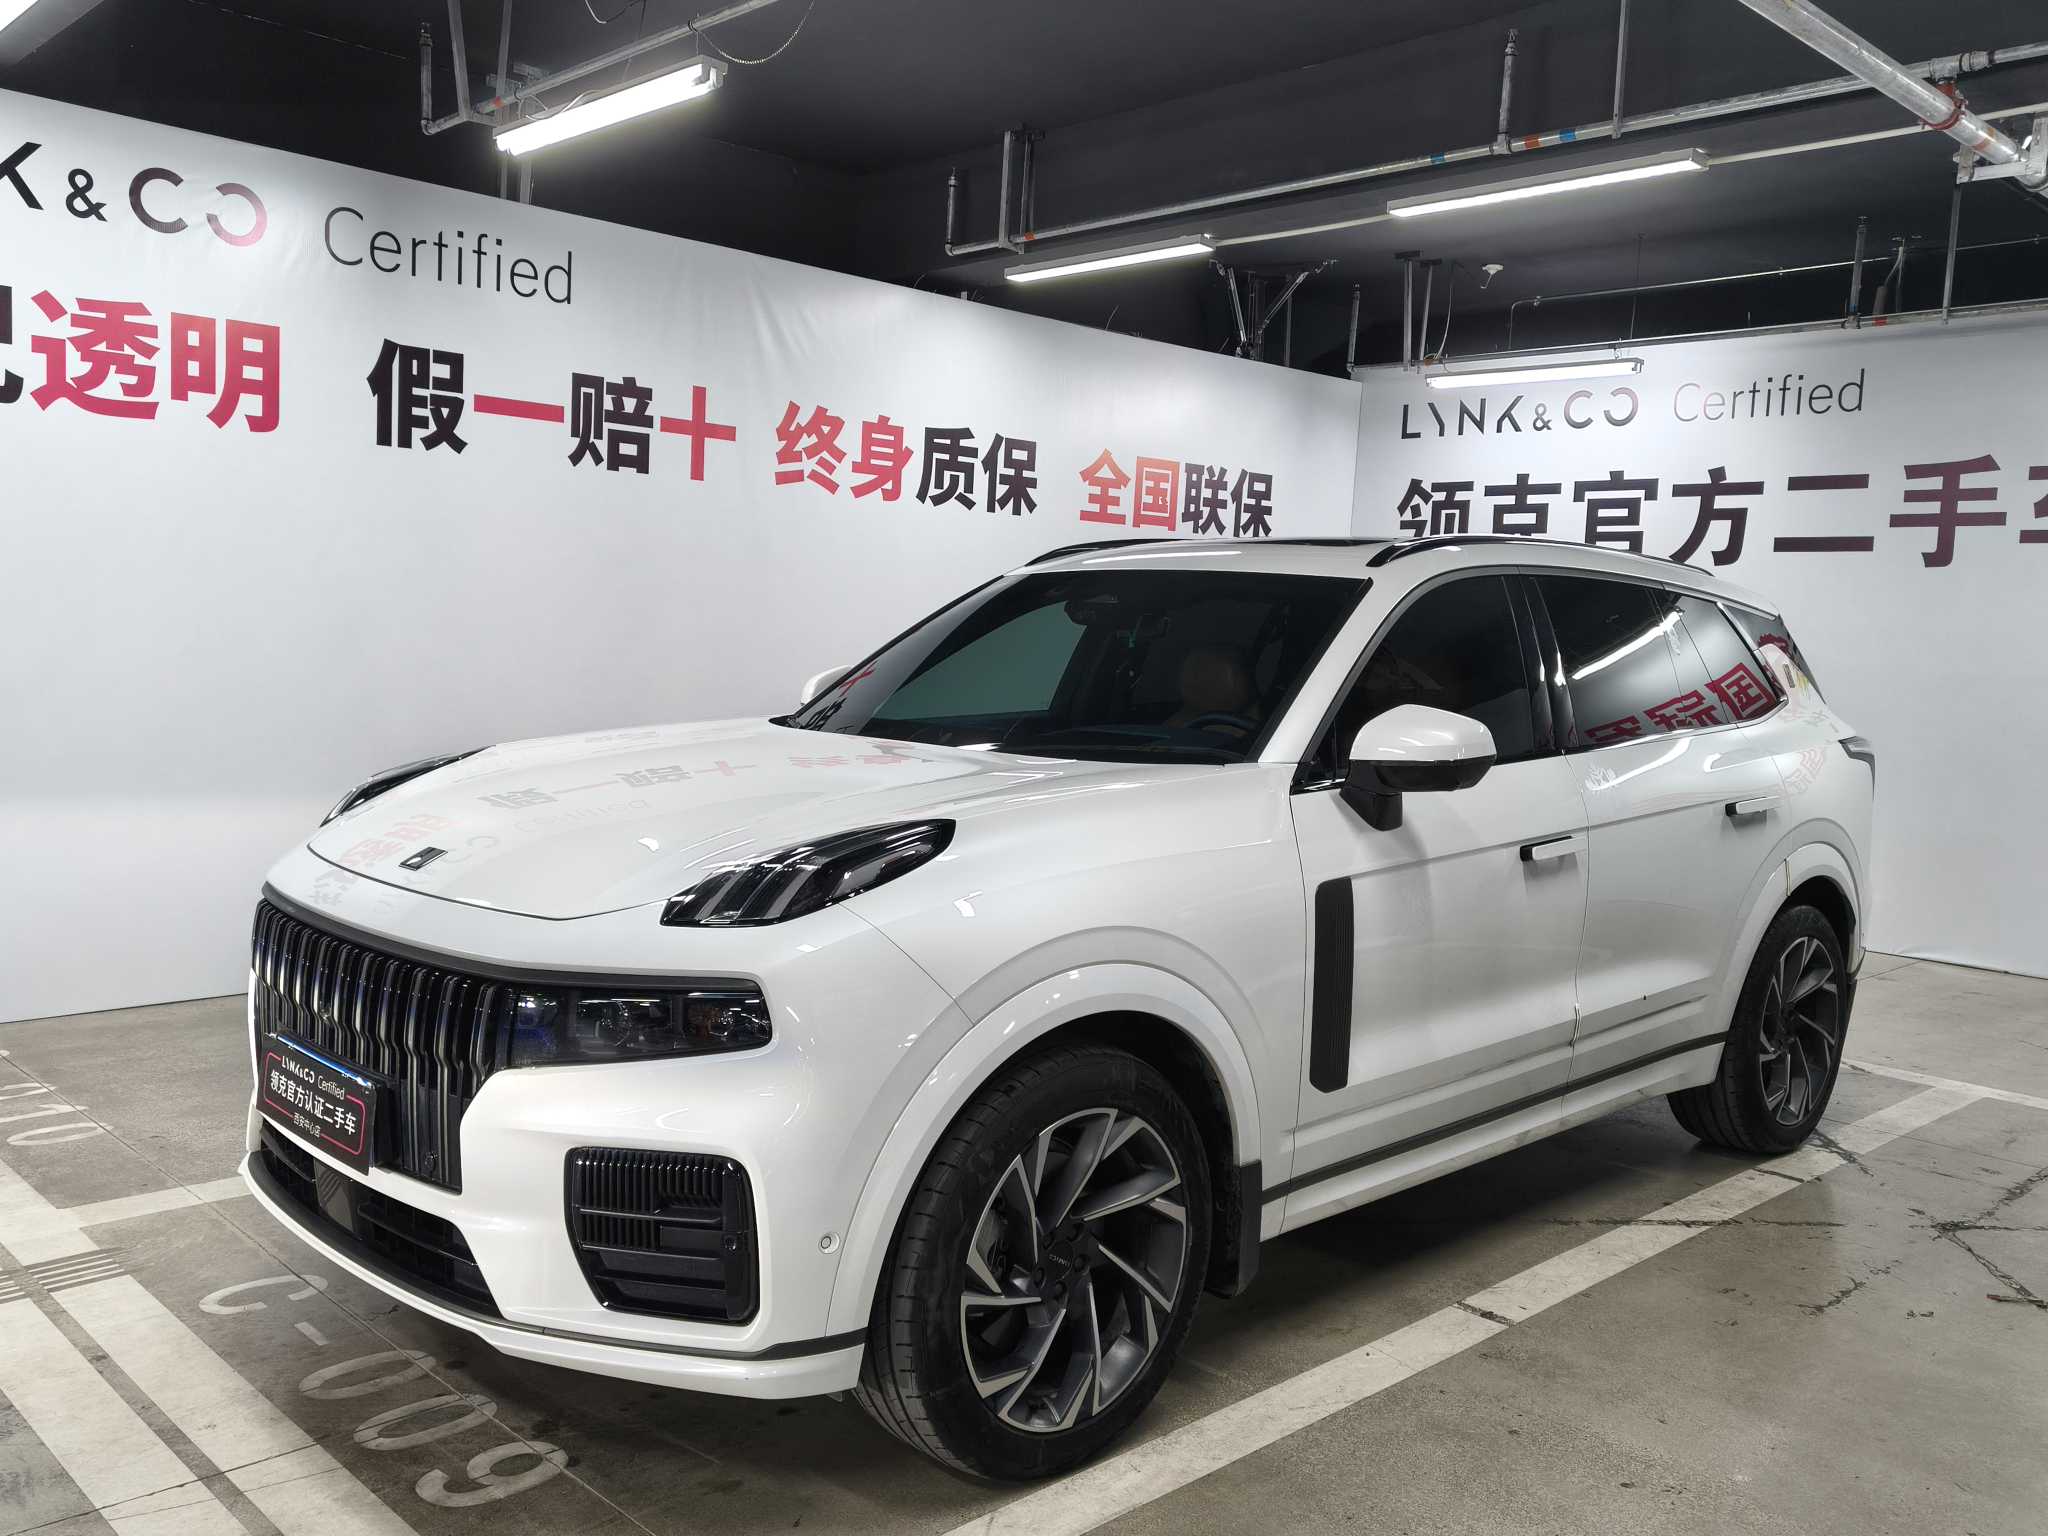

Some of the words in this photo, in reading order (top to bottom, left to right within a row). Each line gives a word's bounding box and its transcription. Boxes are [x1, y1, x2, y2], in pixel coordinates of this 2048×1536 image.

[324, 206, 573, 305] Certified
[366, 337, 737, 482] 假一赔十
[774, 399, 1038, 517] 终身质保
[1079, 447, 1274, 538] 全国联保
[1672, 368, 1866, 423] Certified
[1396, 454, 2048, 568] 领克官方二手
[270, 1069, 357, 1136] 领克官方认证二手车
[317, 1075, 345, 1100] Certified
[199, 1273, 569, 1509] C-009
